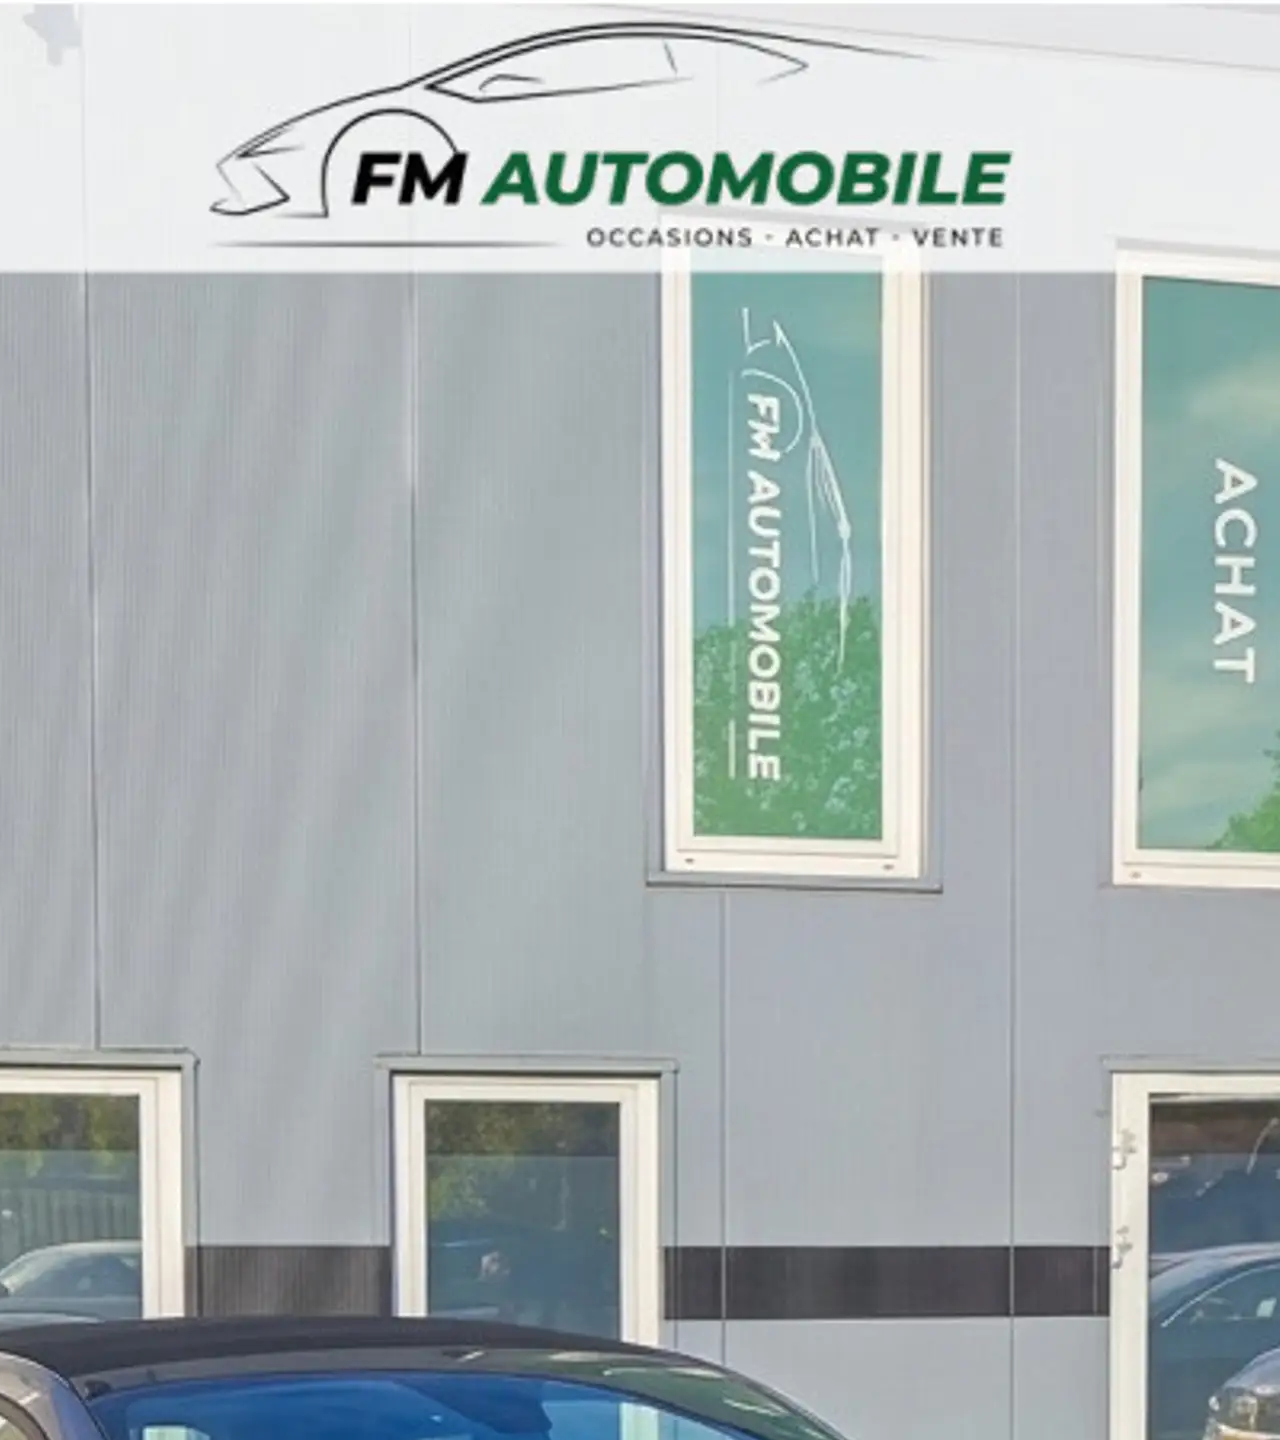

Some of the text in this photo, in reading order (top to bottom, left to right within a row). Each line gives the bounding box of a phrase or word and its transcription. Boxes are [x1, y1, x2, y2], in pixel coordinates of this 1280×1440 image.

[747, 393, 782, 783] FM AUTOMOBILE
[1213, 457, 1259, 684] ACHAT
